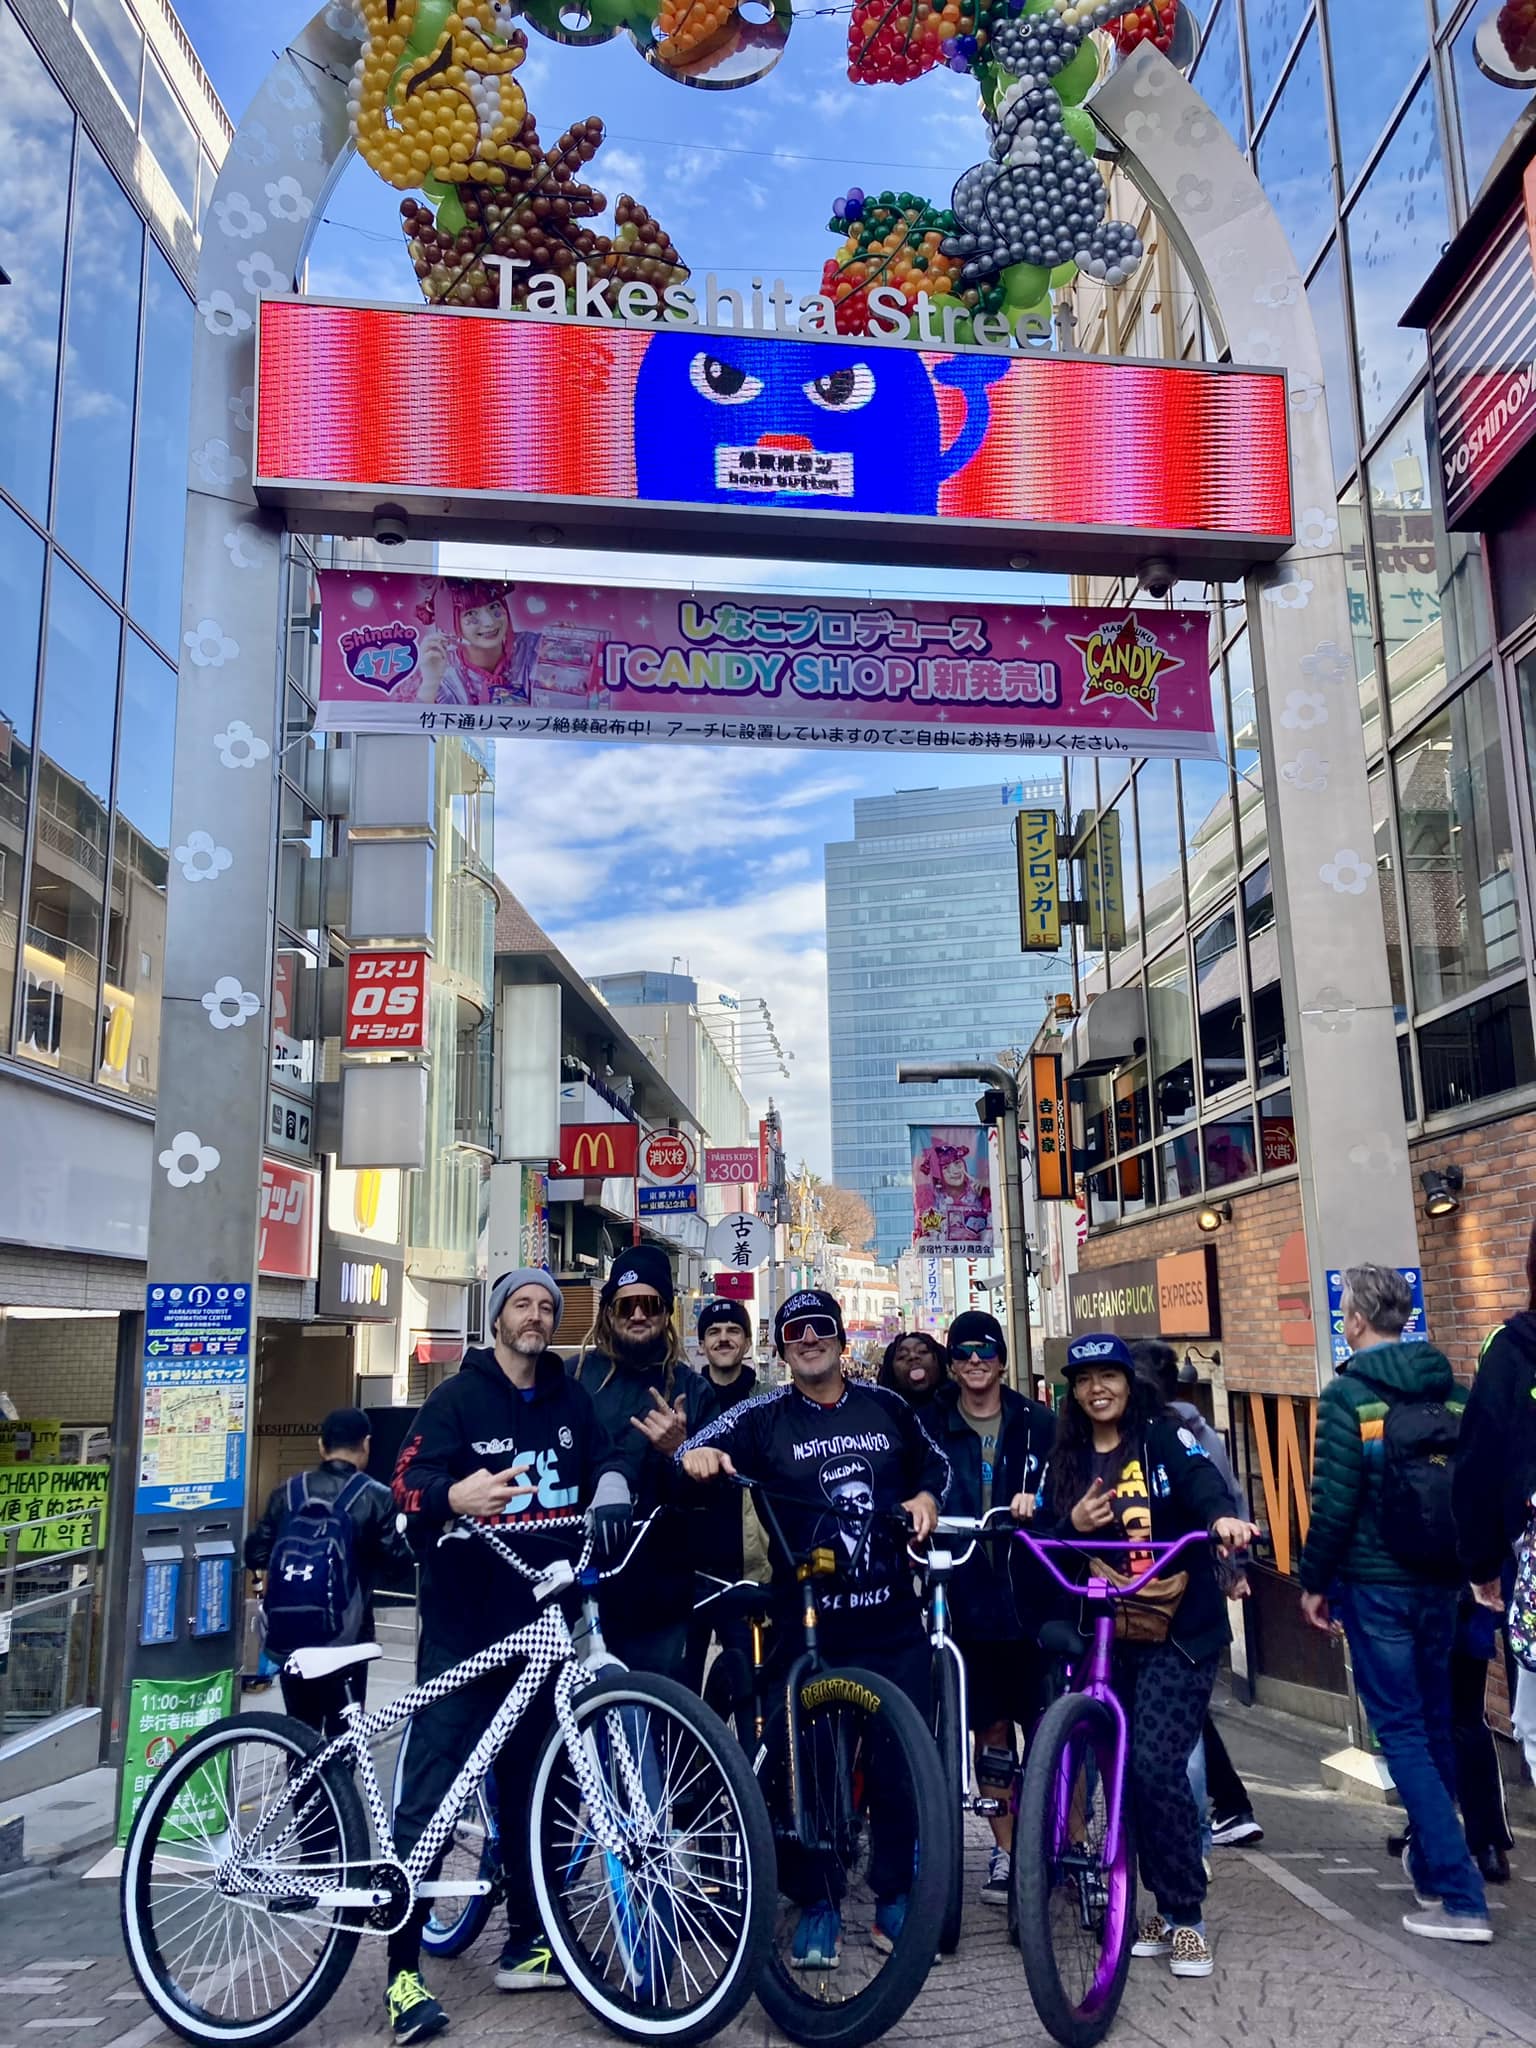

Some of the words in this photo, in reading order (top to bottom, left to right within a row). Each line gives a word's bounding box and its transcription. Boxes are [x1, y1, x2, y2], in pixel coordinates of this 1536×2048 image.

[482, 253, 837, 336] Takeshita
[867, 286, 1082, 353] Street
[340, 622, 418, 654] Shinako
[681, 601, 983, 651] しなこプロデュース
[353, 645, 415, 678] 475
[1086, 634, 1164, 689] CANDY
[420, 711, 651, 737] 竹下通りマップ絶賛配布中!
[667, 721, 1130, 752] アーチに設置していますのでご自由にお持ち帰りください。
[1027, 814, 1054, 930] コインロッカー
[355, 960, 417, 979] クスリ
[351, 986, 419, 1016] OS
[350, 1023, 419, 1040] ドラッグ
[1039, 1098, 1055, 1154] 吉野家
[1056, 1099, 1066, 1152] YOSHINOYA
[649, 1148, 685, 1167] 消火栓
[711, 1153, 733, 1161] PARIS
[711, 1163, 754, 1181] ¥300
[731, 1216, 753, 1266] 古着
[919, 1244, 991, 1254] 原宿竹下通り商店会
[1073, 1289, 1126, 1320] WOLFGANG
[1126, 1285, 1155, 1315] PUCK
[1161, 1281, 1203, 1309] EXPRESS
[146, 1368, 246, 1381] 竹下通り公式マップ
[793, 1432, 890, 1461] INSTITUTIONALIZED
[0, 1472, 47, 1495] CHEAP
[51, 1471, 110, 1494] PHARMACY
[822, 1461, 865, 1483] SUICIDAL
[168, 1486, 191, 1494] TAKE
[192, 1484, 214, 1492] FREE
[821, 1594, 843, 1609] SE
[849, 1586, 890, 1608] BIKES
[139, 1708, 222, 1733] 歩行者用道路
